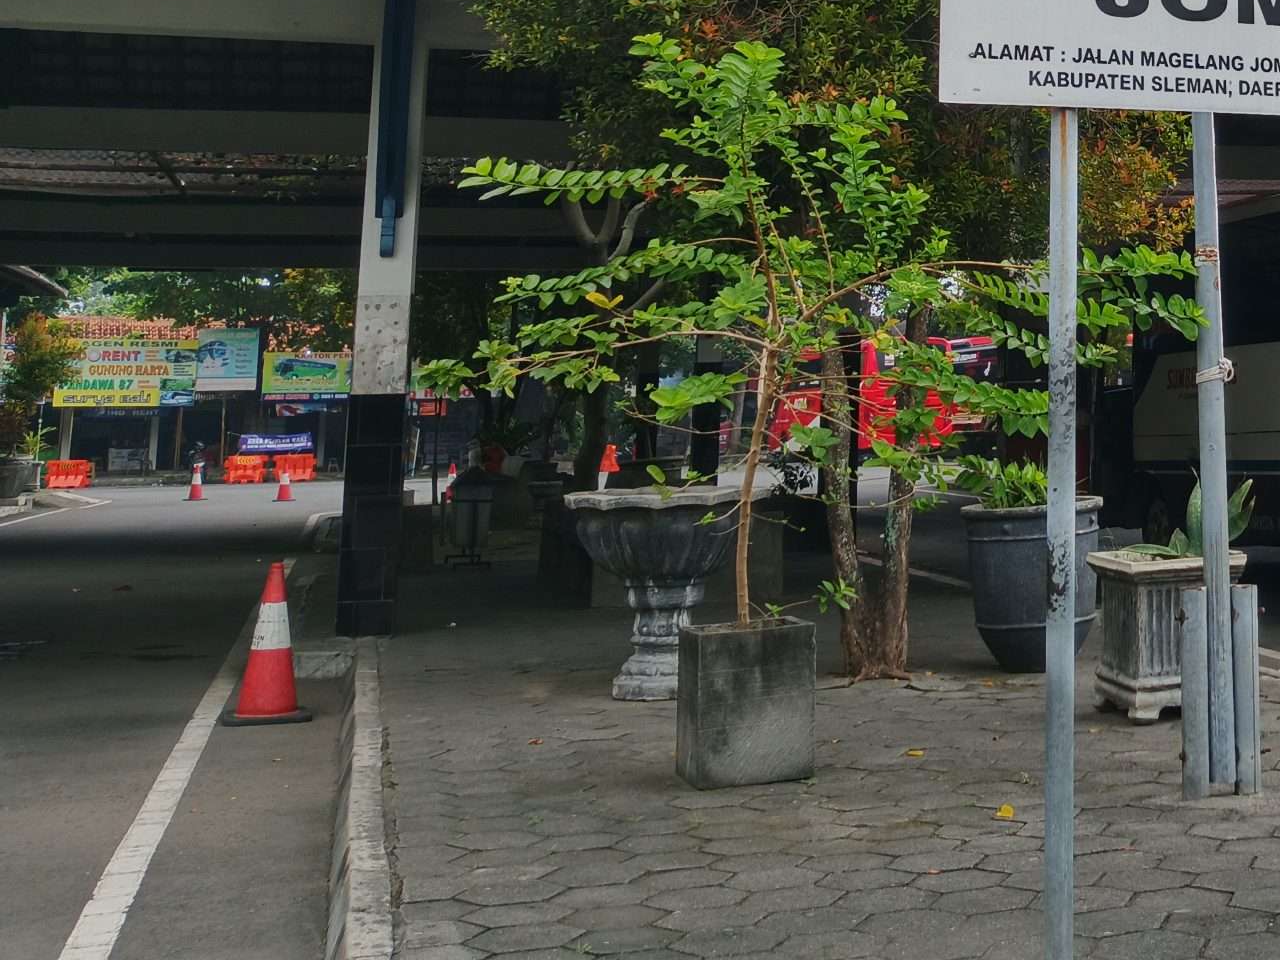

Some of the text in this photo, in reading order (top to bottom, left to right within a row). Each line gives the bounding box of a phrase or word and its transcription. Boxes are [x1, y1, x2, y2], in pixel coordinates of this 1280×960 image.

[972, 42, 1055, 62] ALAMAT
[1072, 47, 1134, 66] JALAN
[1140, 50, 1245, 72] MAGELANG
[1028, 70, 1145, 91] KABUPATEN
[88, 364, 133, 377] GUNUNG
[135, 364, 170, 377] HARTA
[119, 379, 134, 390] 87
